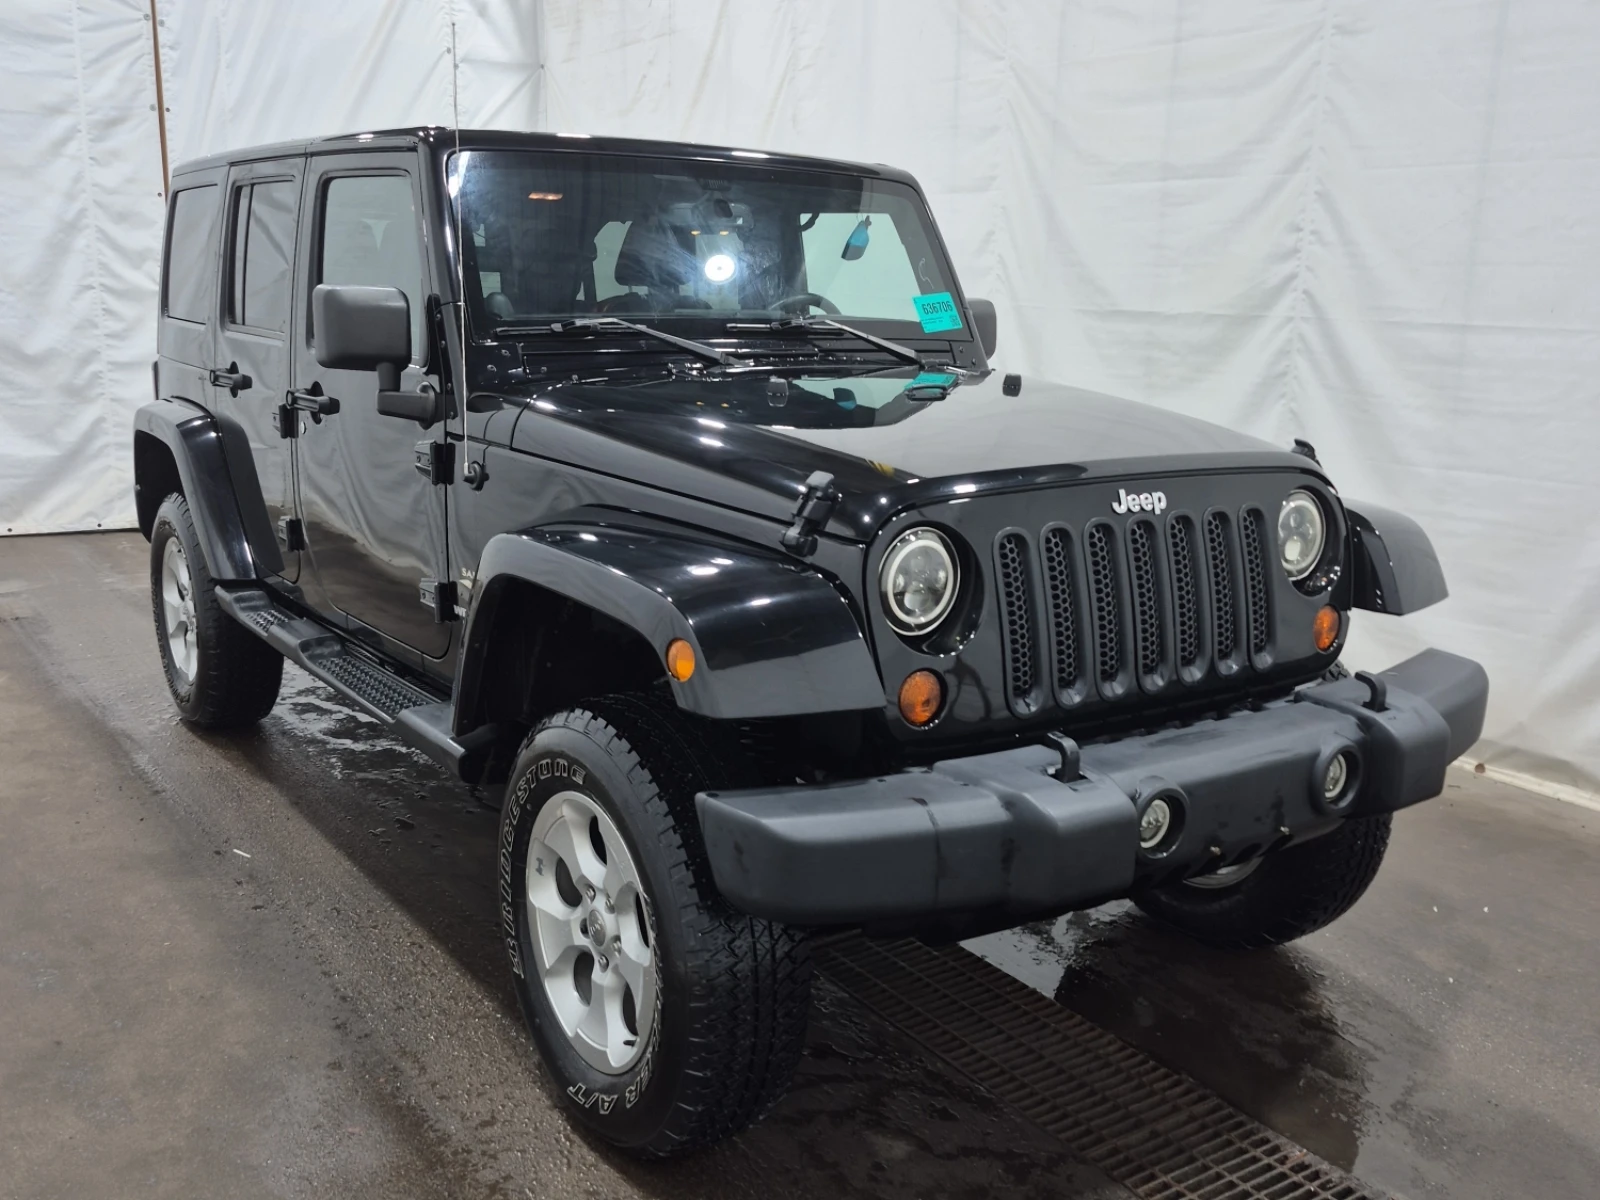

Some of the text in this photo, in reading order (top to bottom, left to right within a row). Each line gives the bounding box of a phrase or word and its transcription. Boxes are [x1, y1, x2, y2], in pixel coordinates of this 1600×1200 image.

[921, 301, 953, 315] 636706
[1111, 488, 1167, 515] Jeep
[500, 757, 587, 980] BRIDGESTONE
